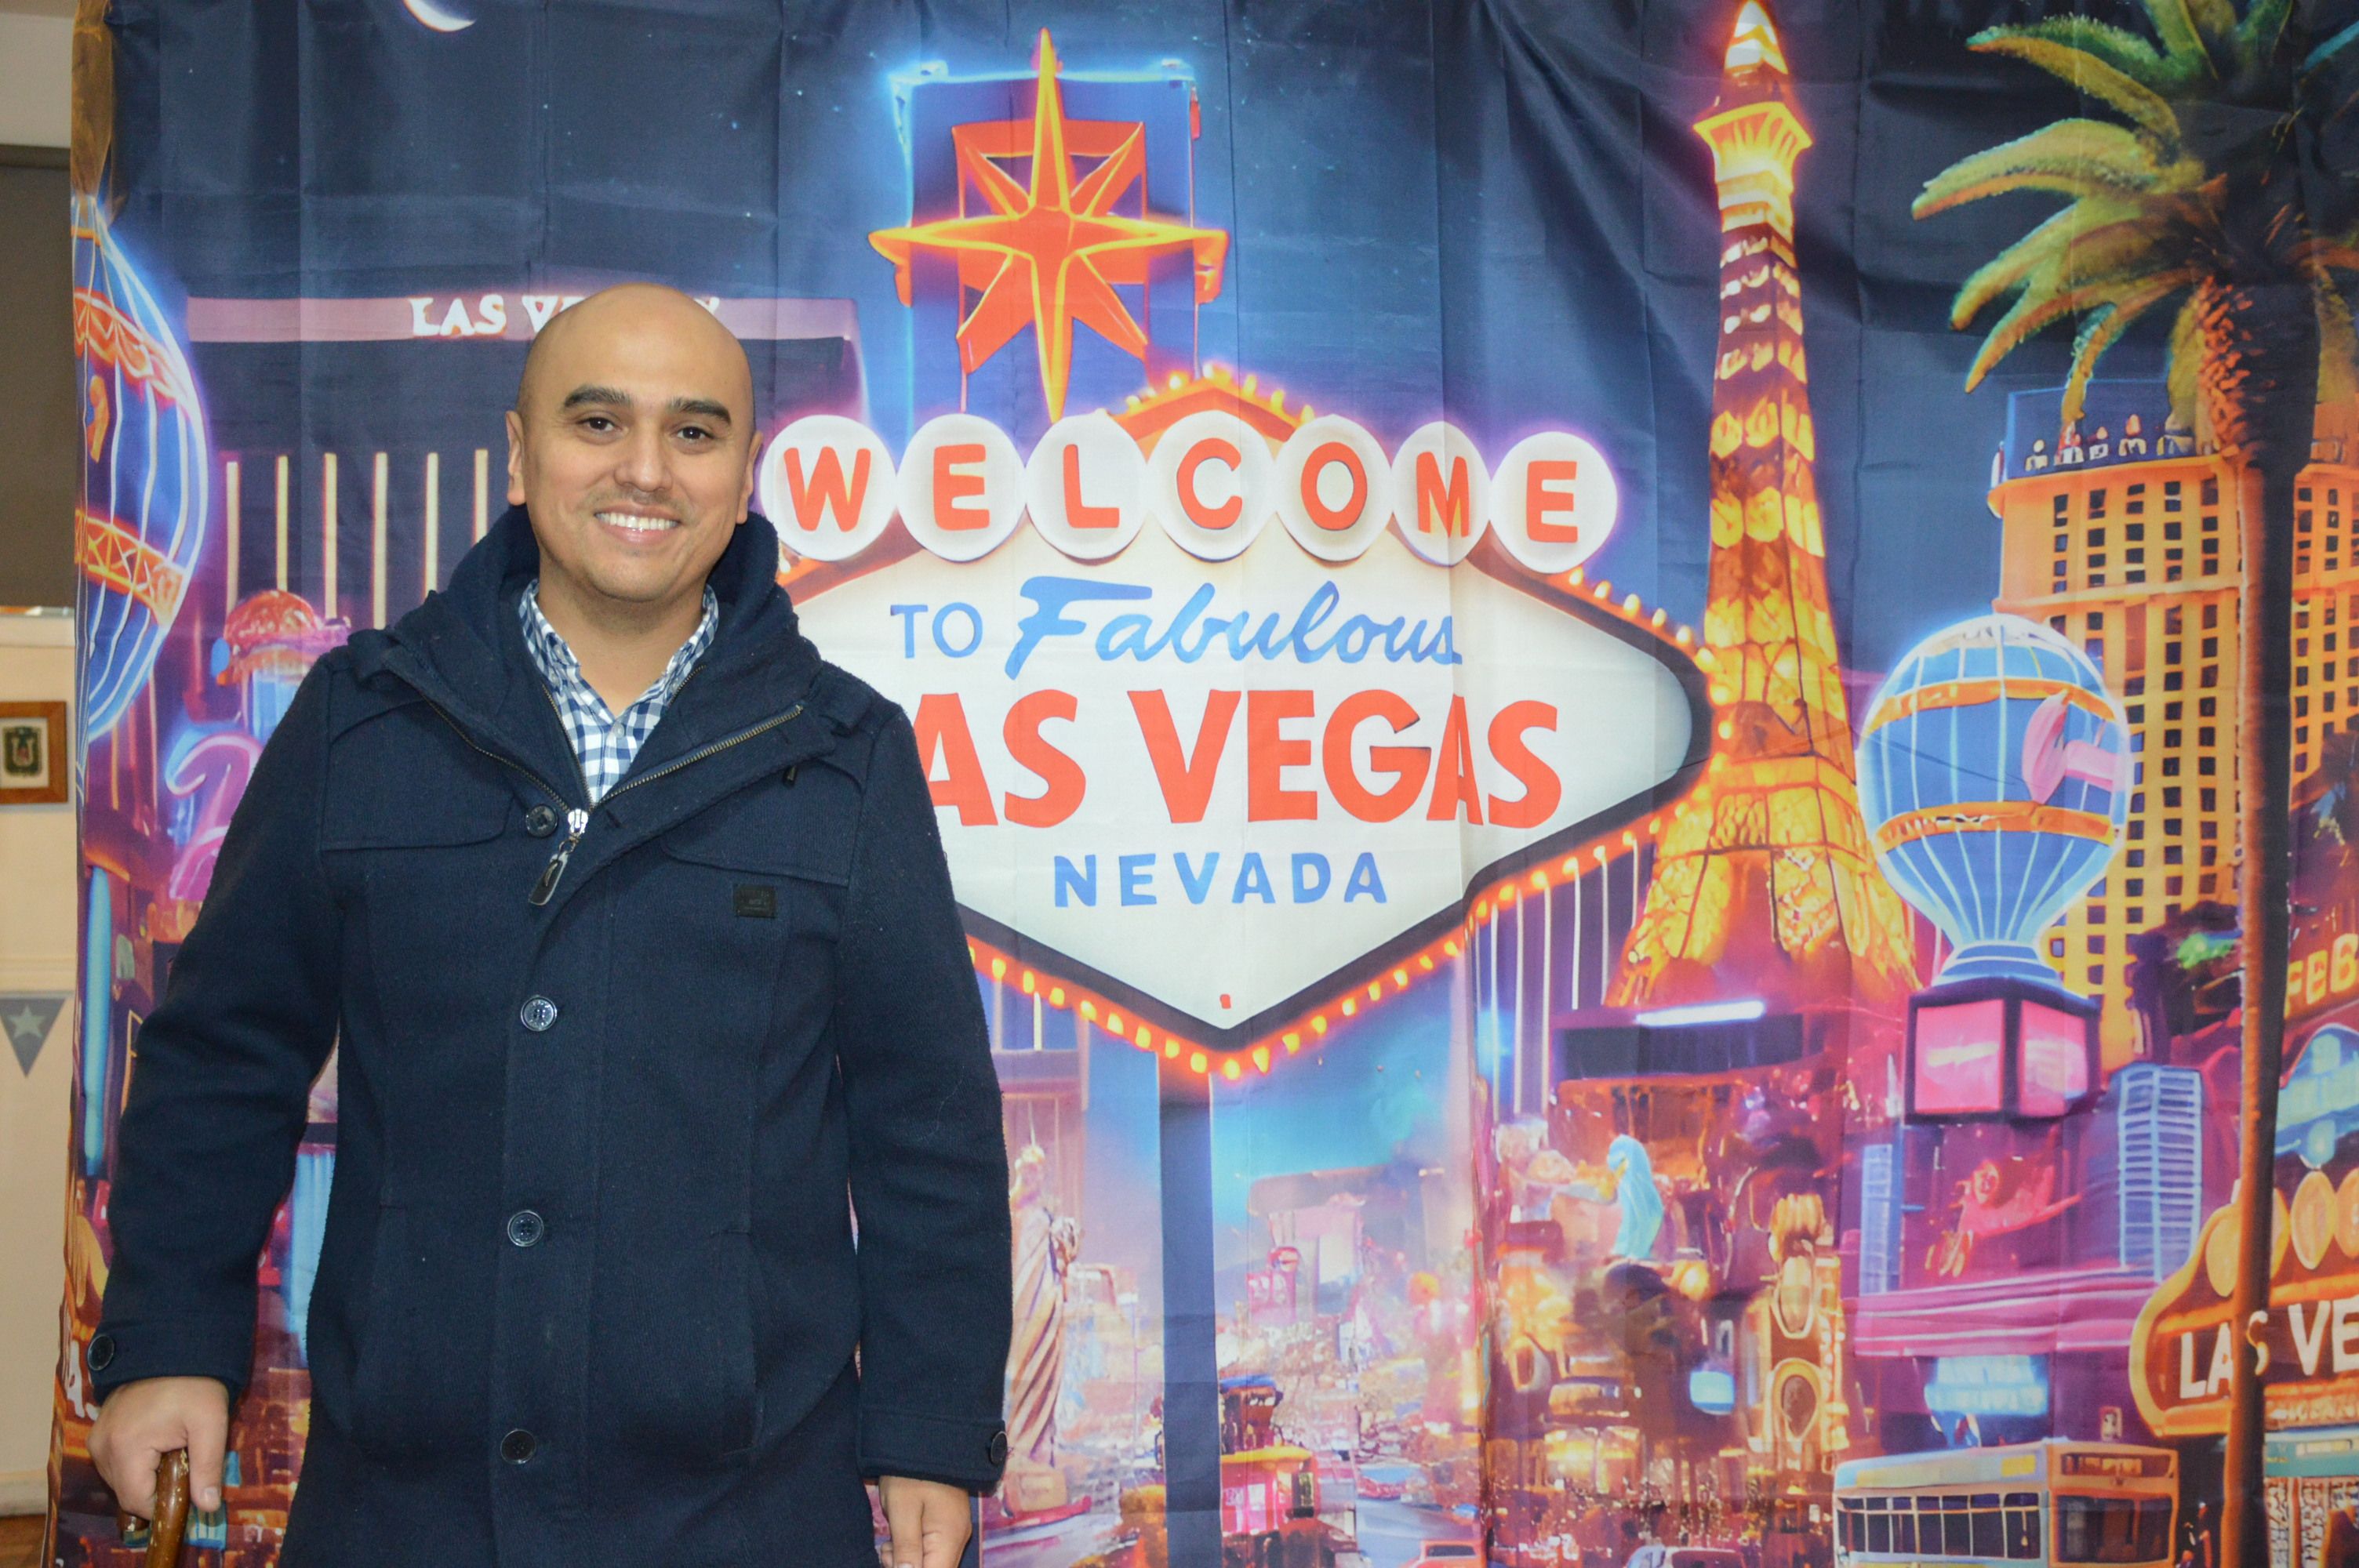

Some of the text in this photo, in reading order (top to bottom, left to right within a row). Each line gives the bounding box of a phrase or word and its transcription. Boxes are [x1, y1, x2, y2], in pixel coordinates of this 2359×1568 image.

[410, 294, 507, 336] LAS
[784, 437, 1579, 543] WELCOME
[890, 576, 1463, 680] TO Fabulous
[913, 689, 1561, 829] AS VEGAS
[1054, 852, 1387, 907] NEVADA
